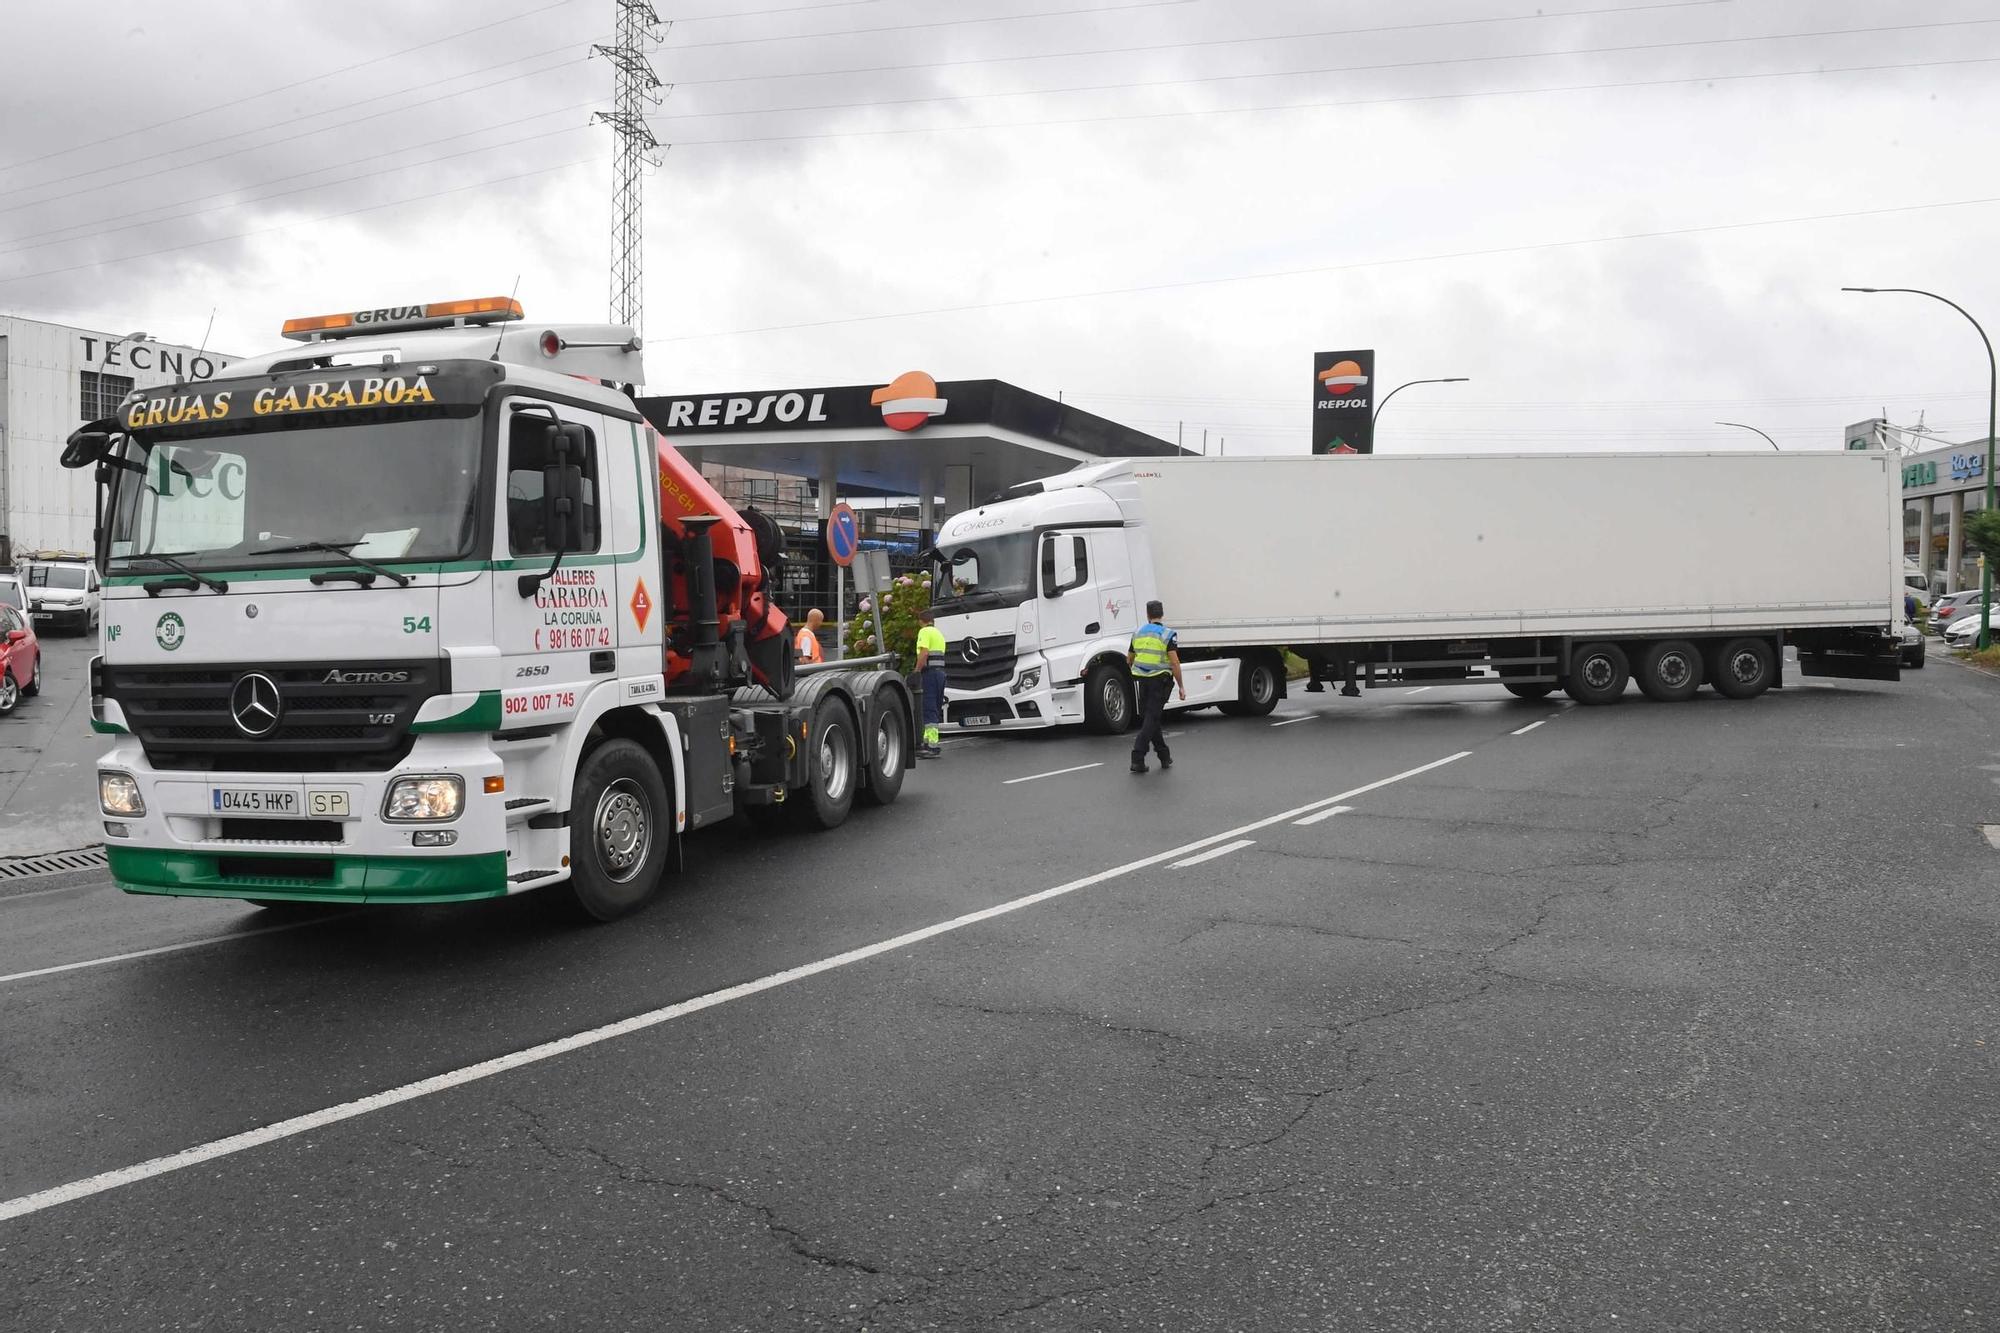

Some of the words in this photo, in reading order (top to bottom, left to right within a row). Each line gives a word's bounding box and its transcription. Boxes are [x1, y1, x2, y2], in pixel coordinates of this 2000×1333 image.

[354, 305, 423, 324] GRUA
[79, 336, 227, 379] TECNO
[127, 391, 232, 428] GRUAS
[252, 375, 436, 415] GARABOA
[667, 392, 828, 428] REPSOL
[1317, 398, 1368, 409] REPSOL
[550, 570, 595, 586] TALLERES
[534, 586, 608, 609] GARABOA
[402, 616, 431, 633] 54
[544, 611, 558, 626] LA
[561, 609, 602, 626] CORUÑA
[107, 624, 121, 642] Nº
[165, 623, 176, 637] 50
[550, 628, 567, 649] 981
[571, 628, 582, 648] 66
[585, 628, 596, 646] 07
[599, 627, 610, 646] 42
[516, 665, 550, 678] 2650
[505, 697, 528, 714] 902
[532, 694, 552, 711] 007
[556, 692, 575, 708] 745
[222, 792, 260, 809] 0445
[265, 793, 293, 810] HKP
